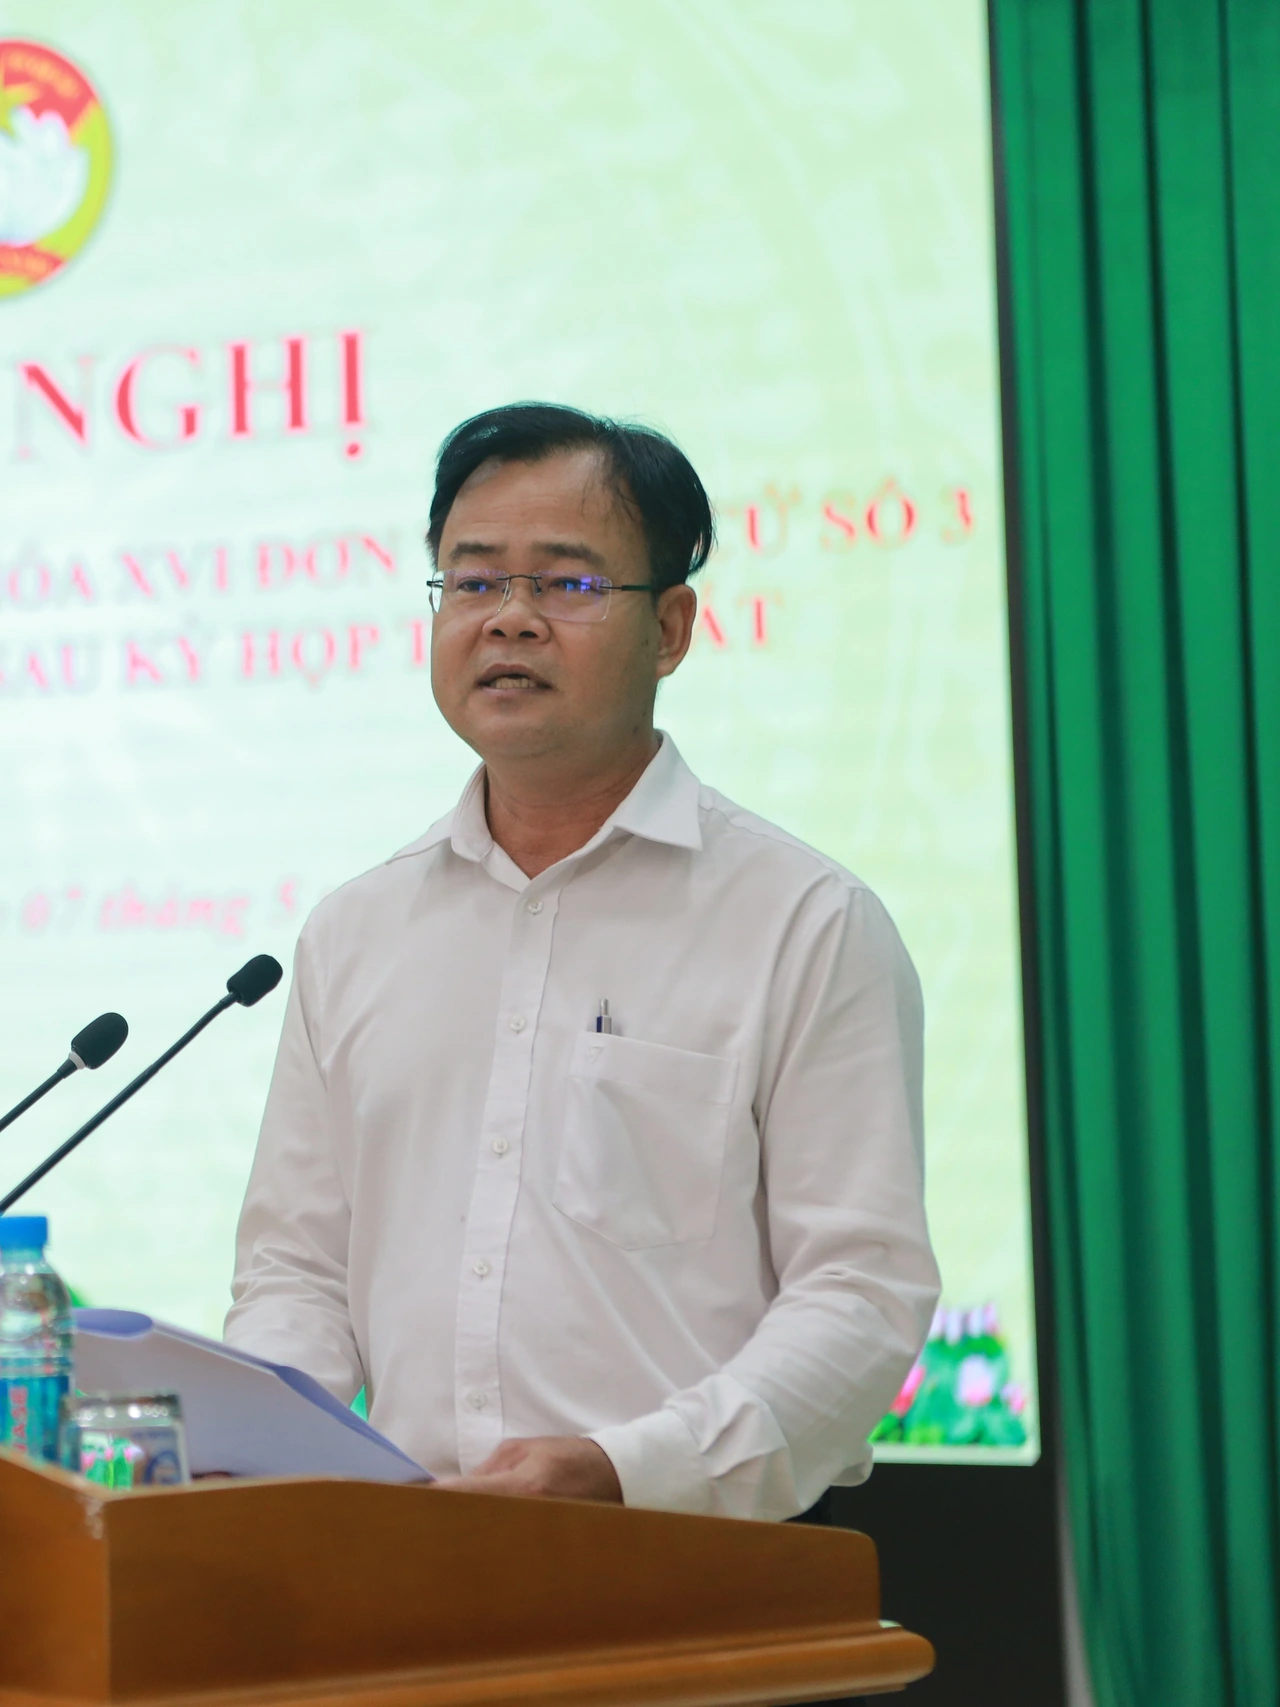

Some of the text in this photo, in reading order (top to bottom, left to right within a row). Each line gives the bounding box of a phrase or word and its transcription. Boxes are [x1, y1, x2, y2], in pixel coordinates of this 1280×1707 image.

[14, 330, 368, 461] NGHỊ
[119, 544, 230, 602] XVI
[819, 476, 919, 551] SỐ
[939, 486, 976, 547] 3
[240, 620, 382, 689] HỌP
